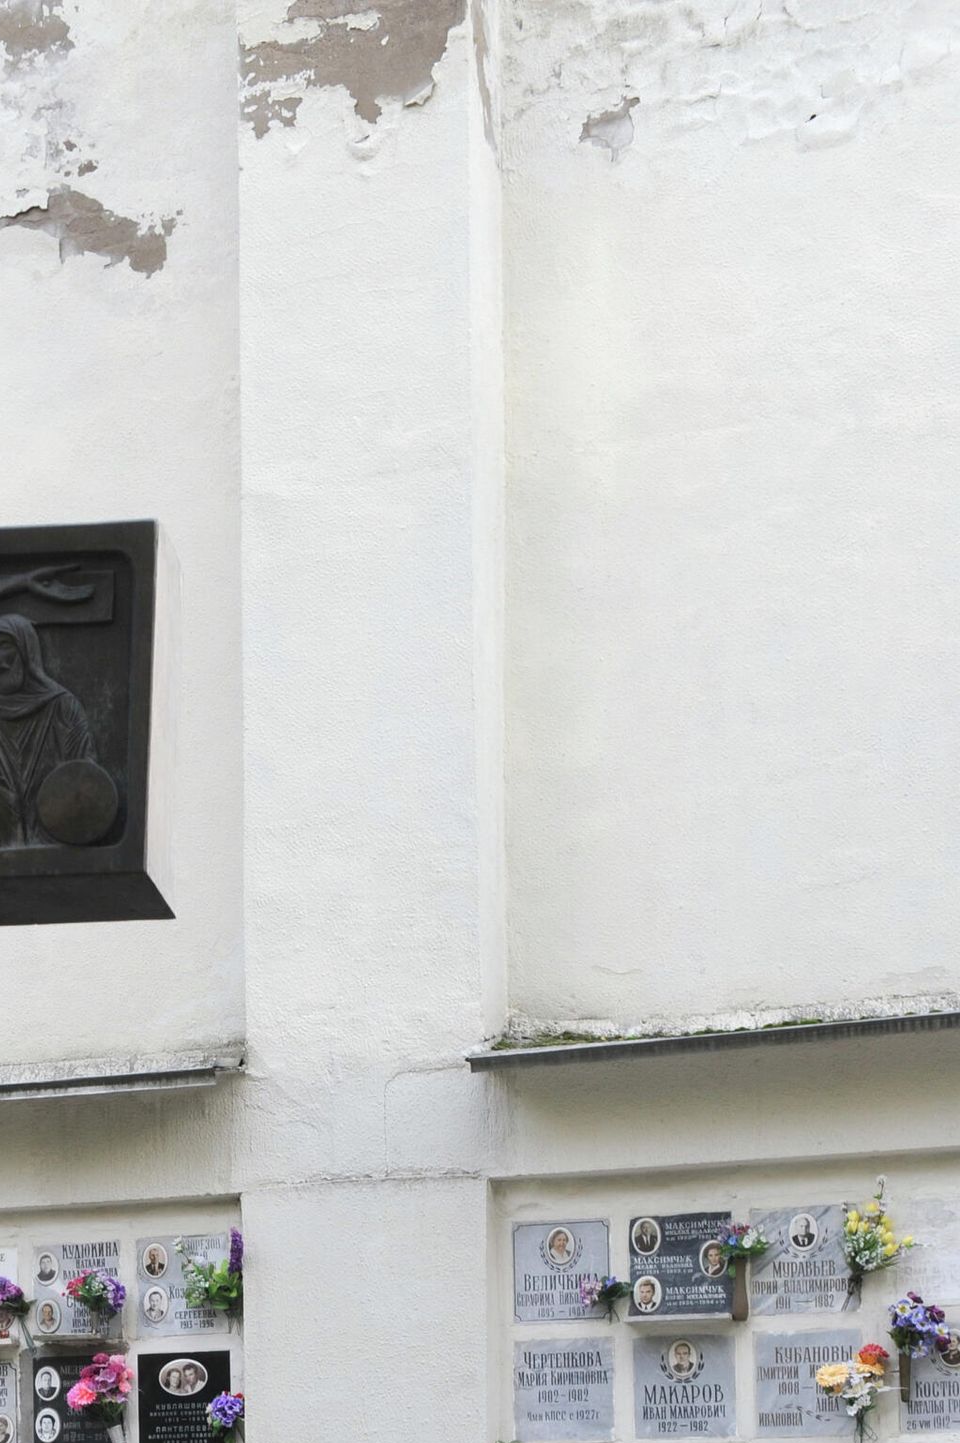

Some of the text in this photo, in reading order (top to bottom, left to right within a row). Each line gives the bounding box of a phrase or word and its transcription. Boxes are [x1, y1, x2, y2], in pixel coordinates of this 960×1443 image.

[62, 1242, 118, 1259] КУДЮКИНА
[633, 1255, 692, 1265] МАКСИМЧУК
[772, 1260, 836, 1278] МУРАВЬЕВ
[665, 1286, 724, 1295] МАКСИМЧУК
[783, 1277, 848, 1294] ВЛАДИМИРОВ
[517, 1293, 555, 1307] СЕРАФИМА
[174, 1310, 217, 1319] СЕРГЕЕВНА
[524, 1351, 602, 1369] ЧЕРТЕНКОВА
[774, 1345, 853, 1364] КУБАНОВЫ
[517, 1370, 608, 1387] МАРИЯ КИРИЛЛОВНА
[644, 1384, 724, 1404] МАКАРОВ
[778, 1381, 800, 1395] 1908
[915, 1380, 960, 1398] КОСТЮ
[155, 1402, 208, 1410] КУБЛАШВИЛ
[642, 1404, 726, 1420] ИВАН МАКАРОВИЧ
[816, 1398, 840, 1413] АННА
[907, 1399, 960, 1415] НАТАЛЬЯ ГР
[545, 1410, 567, 1421] КПСС
[759, 1412, 803, 1427] ИВАНОВНА
[658, 1420, 708, 1433] 1922 1982
[907, 1420, 917, 1430] 26
